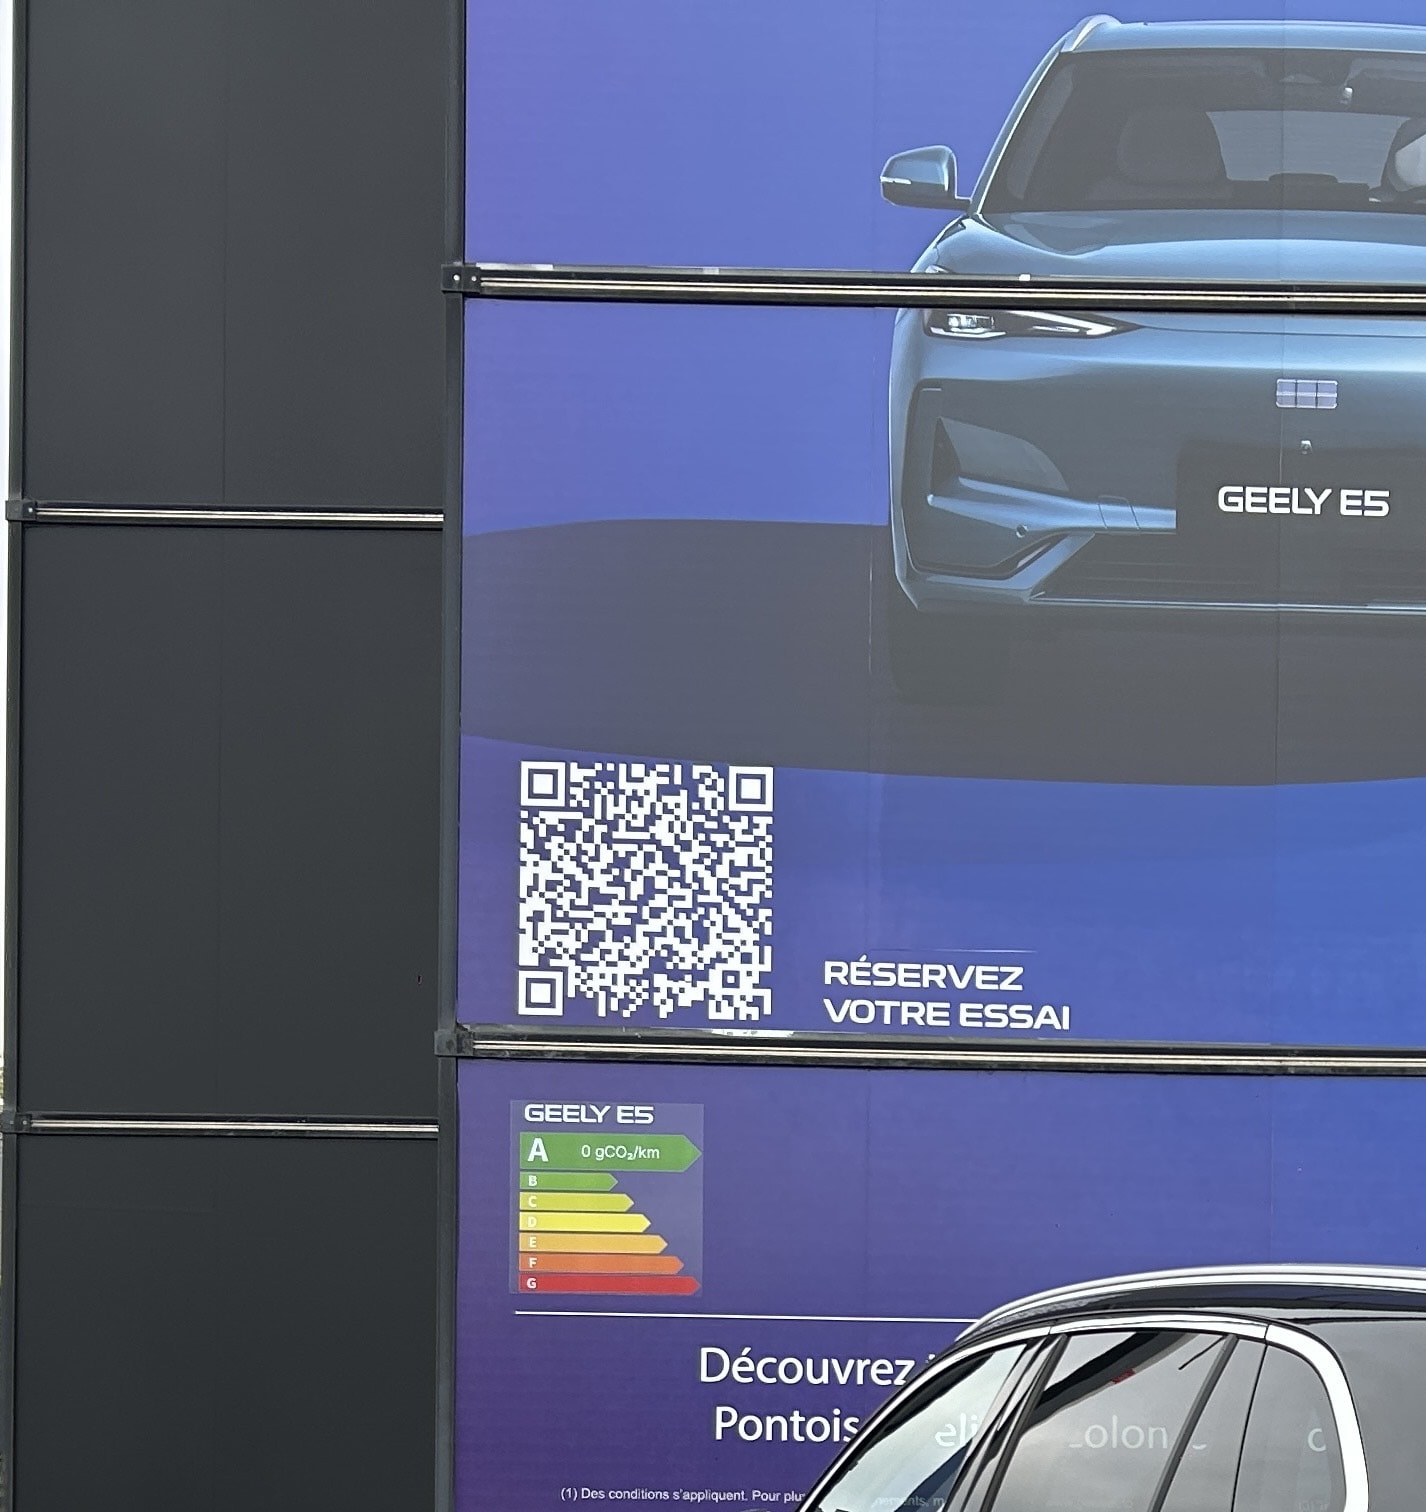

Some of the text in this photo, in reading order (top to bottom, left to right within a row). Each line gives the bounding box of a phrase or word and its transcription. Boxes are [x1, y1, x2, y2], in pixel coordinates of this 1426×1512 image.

[1217, 485, 1390, 517] GEELY E5
[824, 954, 1024, 991] RÉSERVEZ
[823, 998, 1070, 1030] VOTRE ESSAI
[524, 1103, 654, 1124] GEELY E5
[527, 1137, 549, 1162] A
[581, 1145, 591, 1158] 0
[528, 1175, 538, 1187] B
[527, 1195, 537, 1208] C
[527, 1216, 537, 1228] D
[529, 1236, 537, 1248] E
[529, 1257, 538, 1269] F
[526, 1277, 537, 1289] G
[699, 1346, 916, 1386] Découvrez
[560, 1487, 578, 1502] (1)
[581, 1487, 606, 1500] Des
[608, 1488, 669, 1501] conditions
[752, 1490, 781, 1502] Pour
